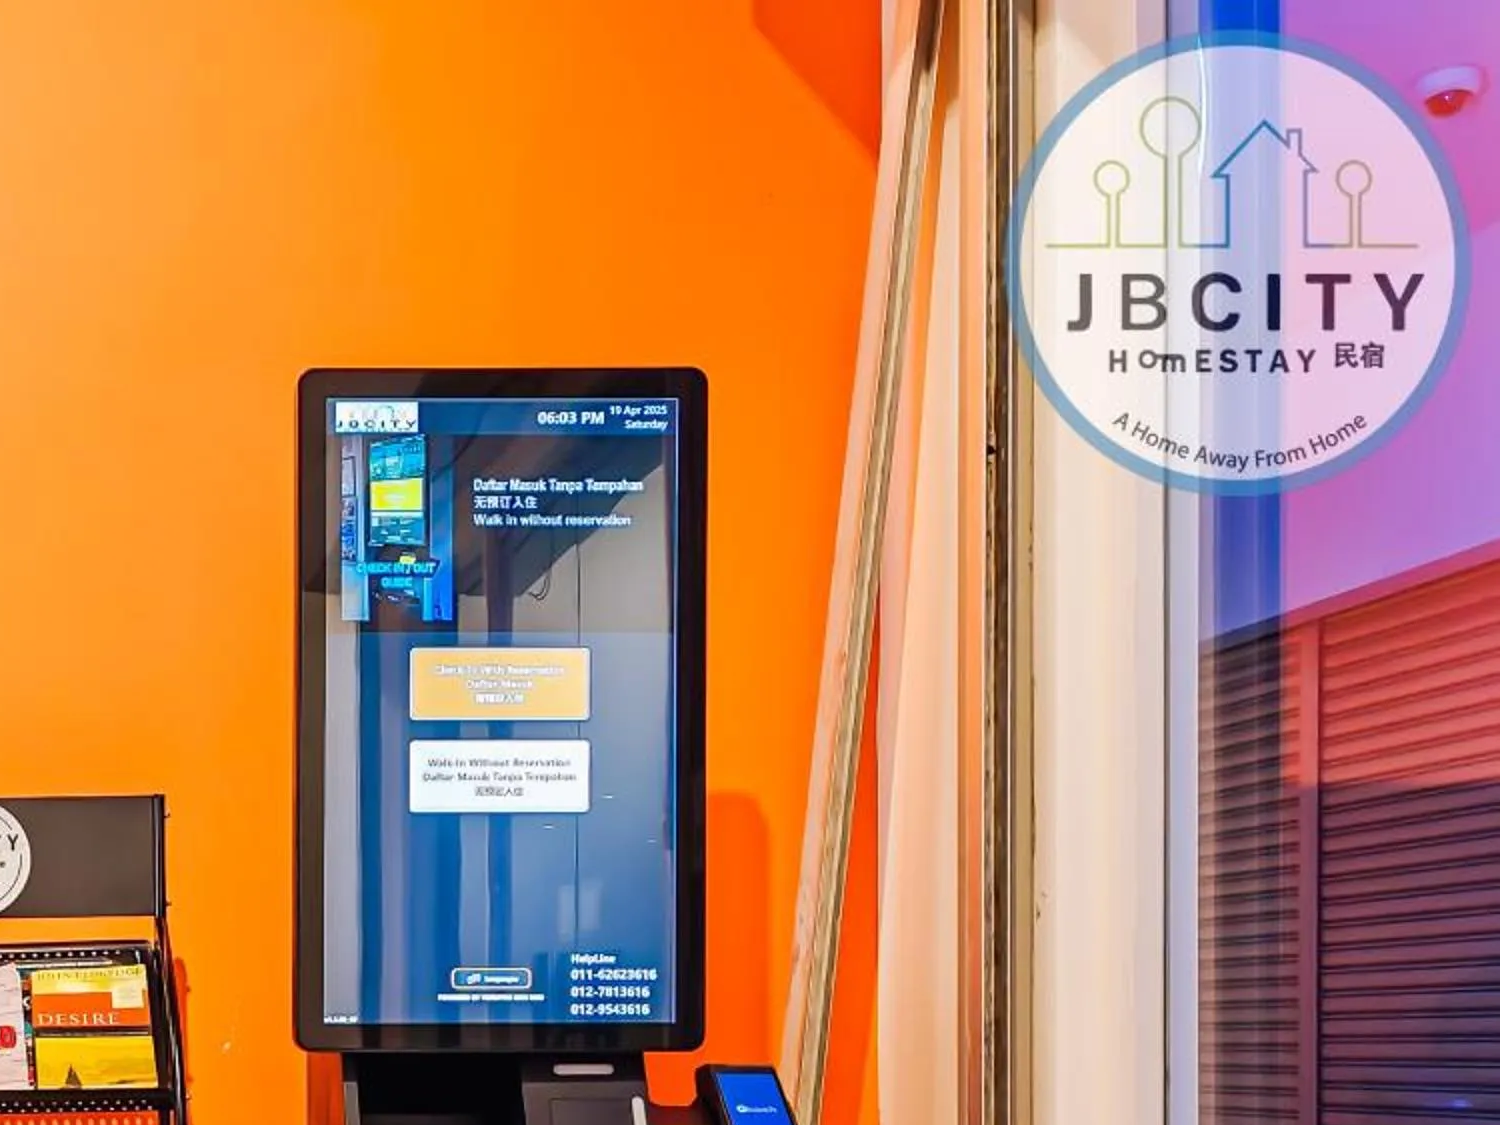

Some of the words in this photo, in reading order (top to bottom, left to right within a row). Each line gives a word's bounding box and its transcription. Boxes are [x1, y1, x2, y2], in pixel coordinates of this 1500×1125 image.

[537, 411, 578, 425] 06:03
[581, 411, 605, 425] PM
[623, 405, 642, 417] Apr
[643, 405, 668, 416] 2025
[624, 418, 669, 432] Saturday
[473, 478, 508, 491] Daftar
[510, 478, 547, 491] Masuk
[549, 478, 584, 494] Tanpa
[585, 478, 644, 494] Tempahan
[473, 513, 503, 526] Walk
[505, 513, 517, 526] in
[519, 513, 563, 526] without
[565, 513, 632, 526] reservation
[37, 1012, 120, 1026] DESIRE
